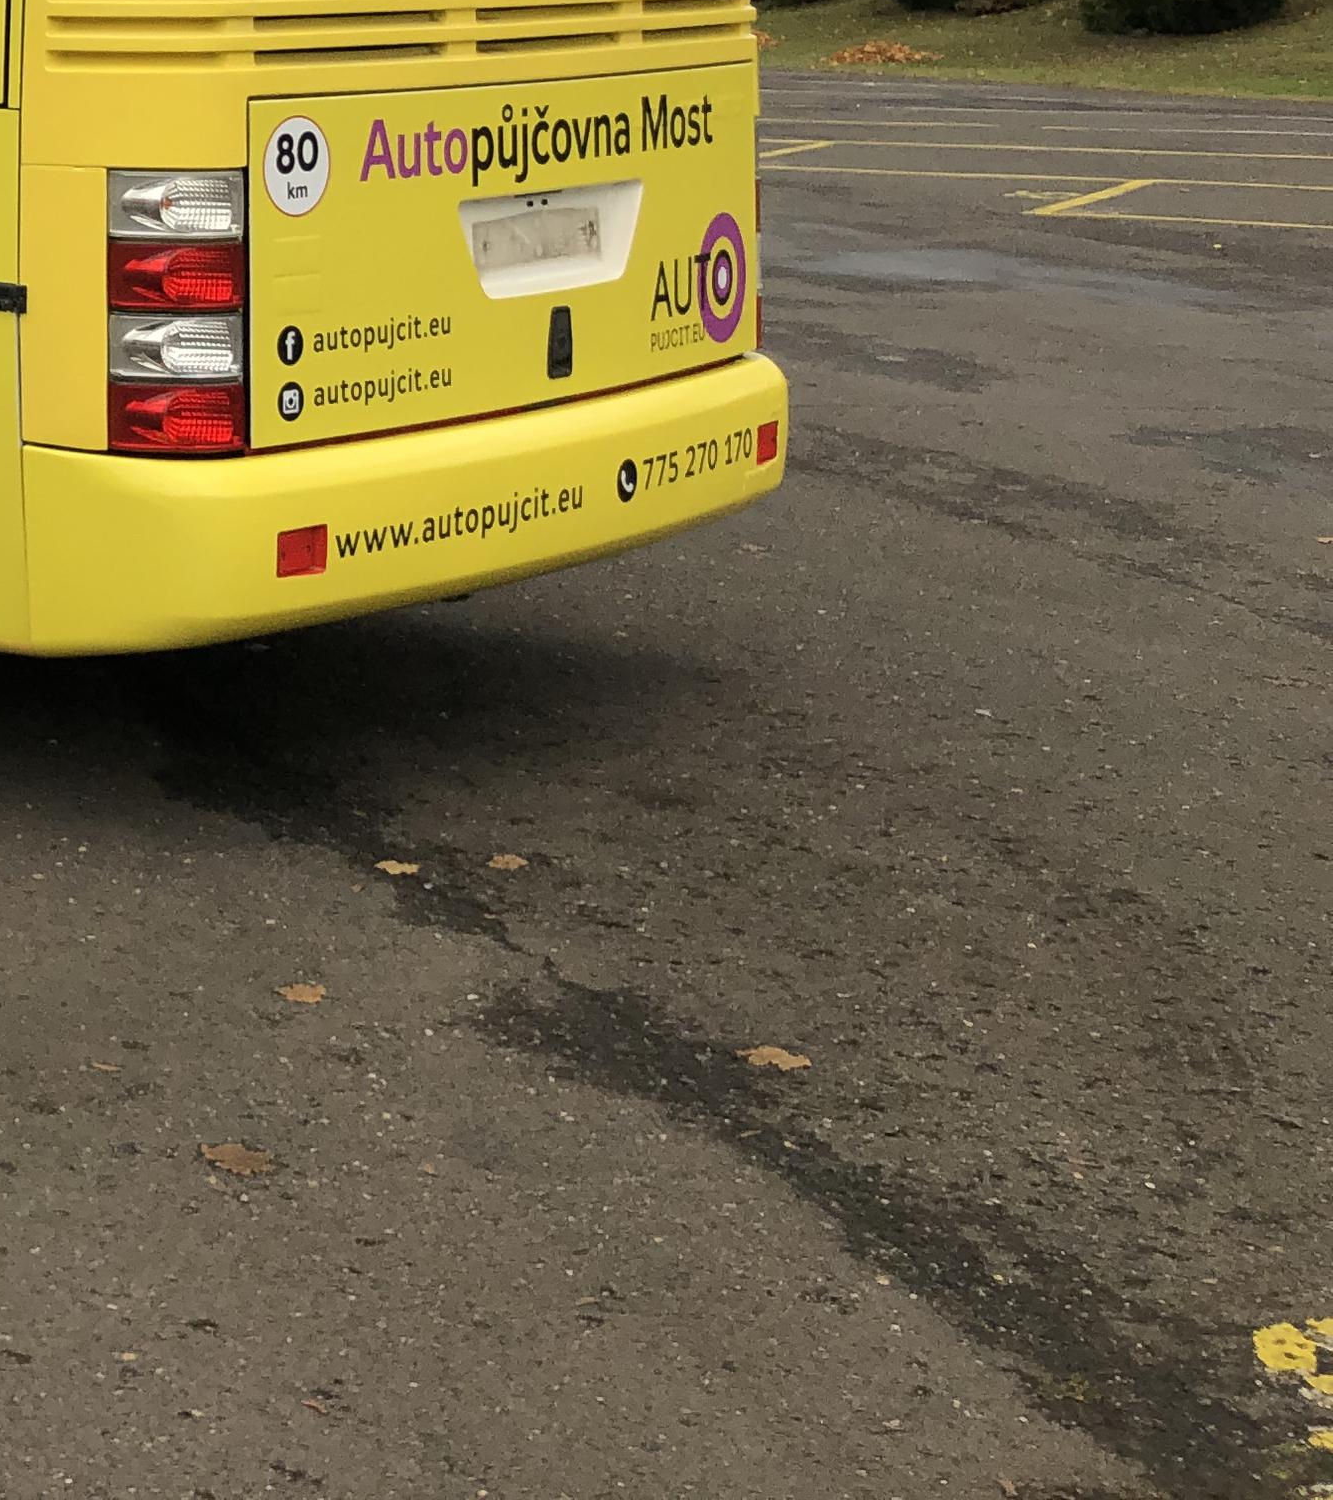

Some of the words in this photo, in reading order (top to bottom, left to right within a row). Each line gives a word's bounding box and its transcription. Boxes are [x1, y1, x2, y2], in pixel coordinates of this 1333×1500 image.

[276, 131, 319, 175] 80
[359, 104, 631, 187] Autopůjčovna
[641, 94, 714, 152] Most
[287, 182, 308, 200] km
[650, 249, 733, 322] AUTO
[313, 314, 451, 353] autopujcit.eu
[313, 367, 452, 407] autopujcit.eu
[643, 450, 679, 490] 775
[684, 439, 718, 478] 270
[725, 427, 753, 466] 170
[335, 483, 583, 559] www.autopujcit.eu
